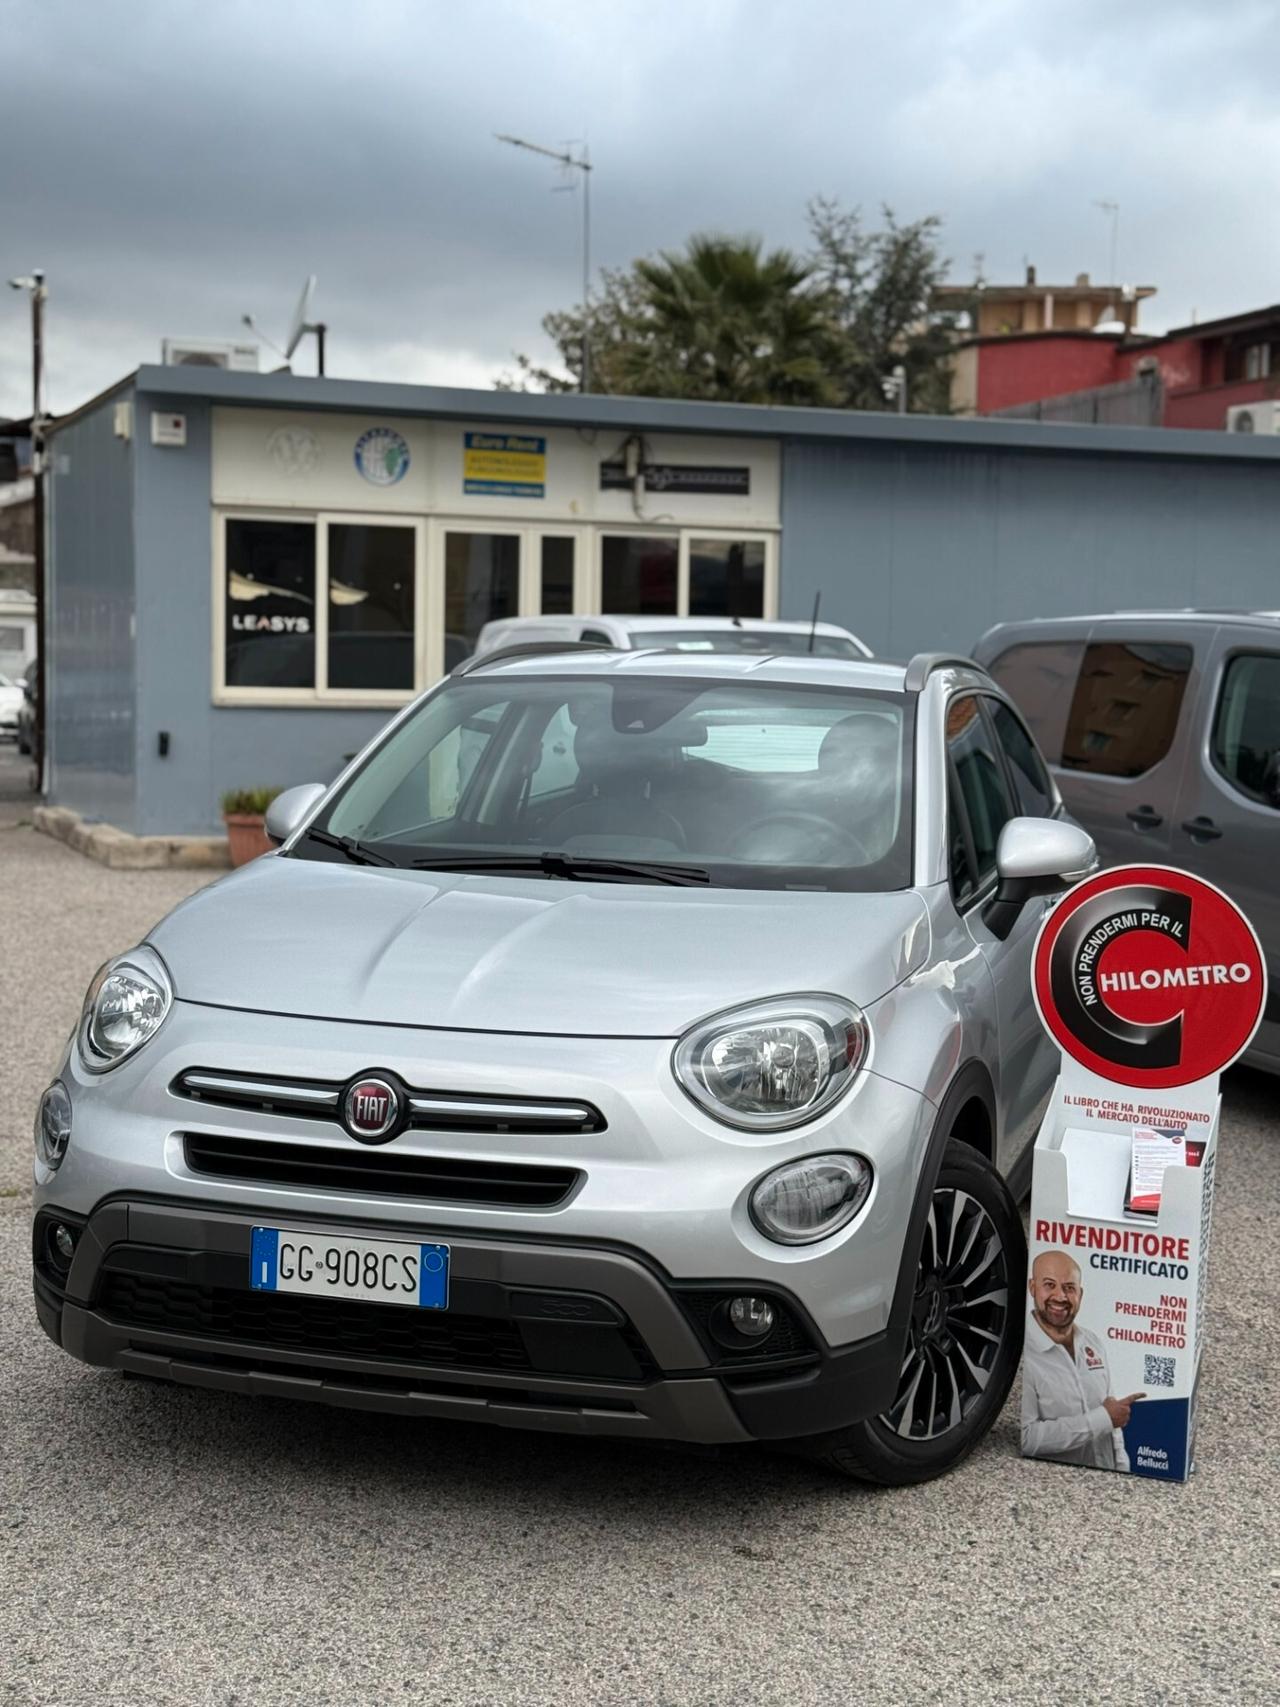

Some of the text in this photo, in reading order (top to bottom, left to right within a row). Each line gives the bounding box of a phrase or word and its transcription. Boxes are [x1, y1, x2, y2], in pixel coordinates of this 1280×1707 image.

[232, 614, 310, 633] LEASYS
[1079, 912, 1184, 1006] NON PRENDERMI PER IL
[356, 1096, 387, 1122] FIAT
[1064, 1095, 1210, 1123] IL LIBRO CHE HA RIVOLUZIONATO
[1086, 1109, 1188, 1130] IL MERCATO DELL'AUTO
[1036, 1219, 1190, 1260] RIVENDITORE
[1090, 1253, 1189, 1280] CERTIFICATO
[1115, 1302, 1186, 1322] PRENDERMI
[1160, 1295, 1187, 1309] NON
[1107, 1327, 1186, 1349] CHILOMETRO
[1150, 1320, 1187, 1336] PER IL
[1137, 1446, 1167, 1459] Alfredo
[1137, 1457, 1169, 1470] Bellucci
